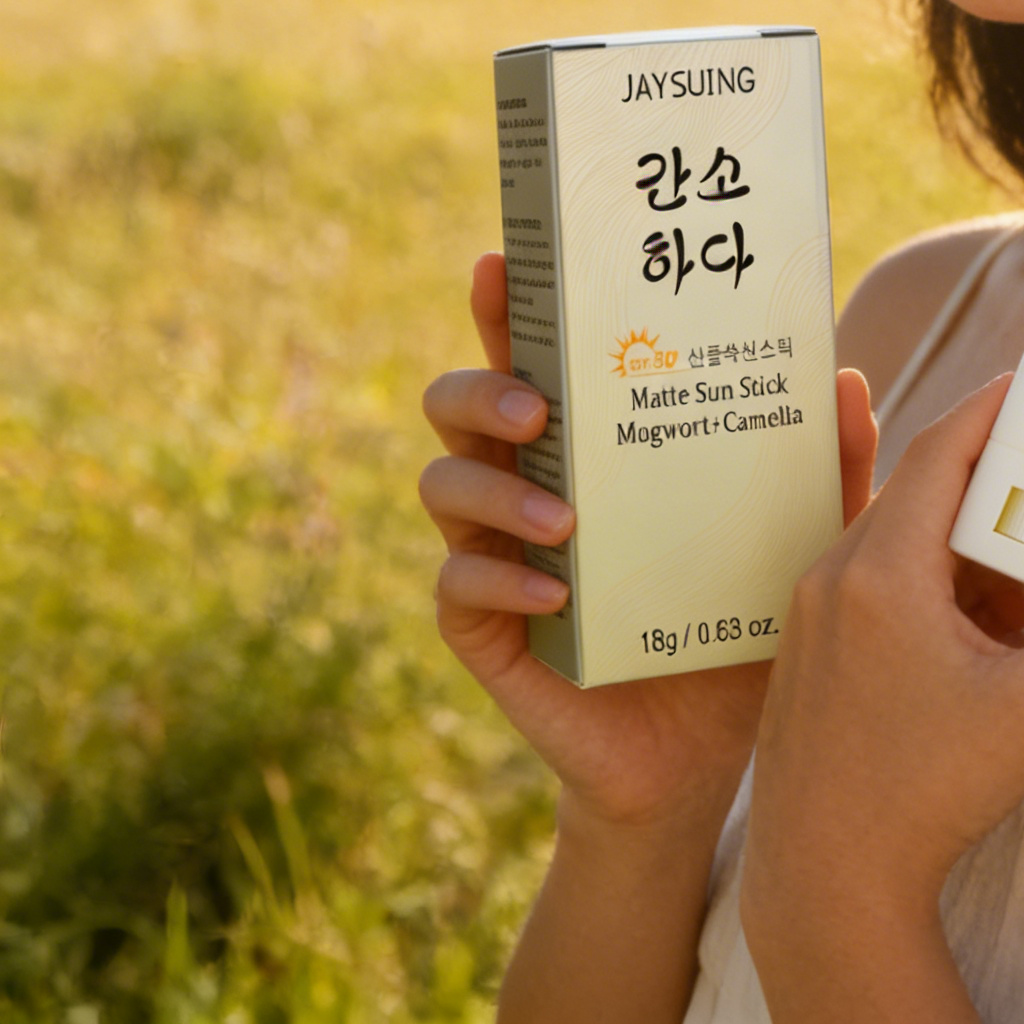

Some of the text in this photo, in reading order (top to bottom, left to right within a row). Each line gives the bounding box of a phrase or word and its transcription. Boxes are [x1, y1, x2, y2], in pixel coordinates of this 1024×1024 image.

[621, 66, 756, 103] JAYSUING
[642, 221, 755, 296] 하다
[631, 373, 789, 411] Matte Sun Stick
[641, 628, 677, 656] 18g
[698, 617, 742, 645] 0.63
[748, 617, 780, 637] oz.
